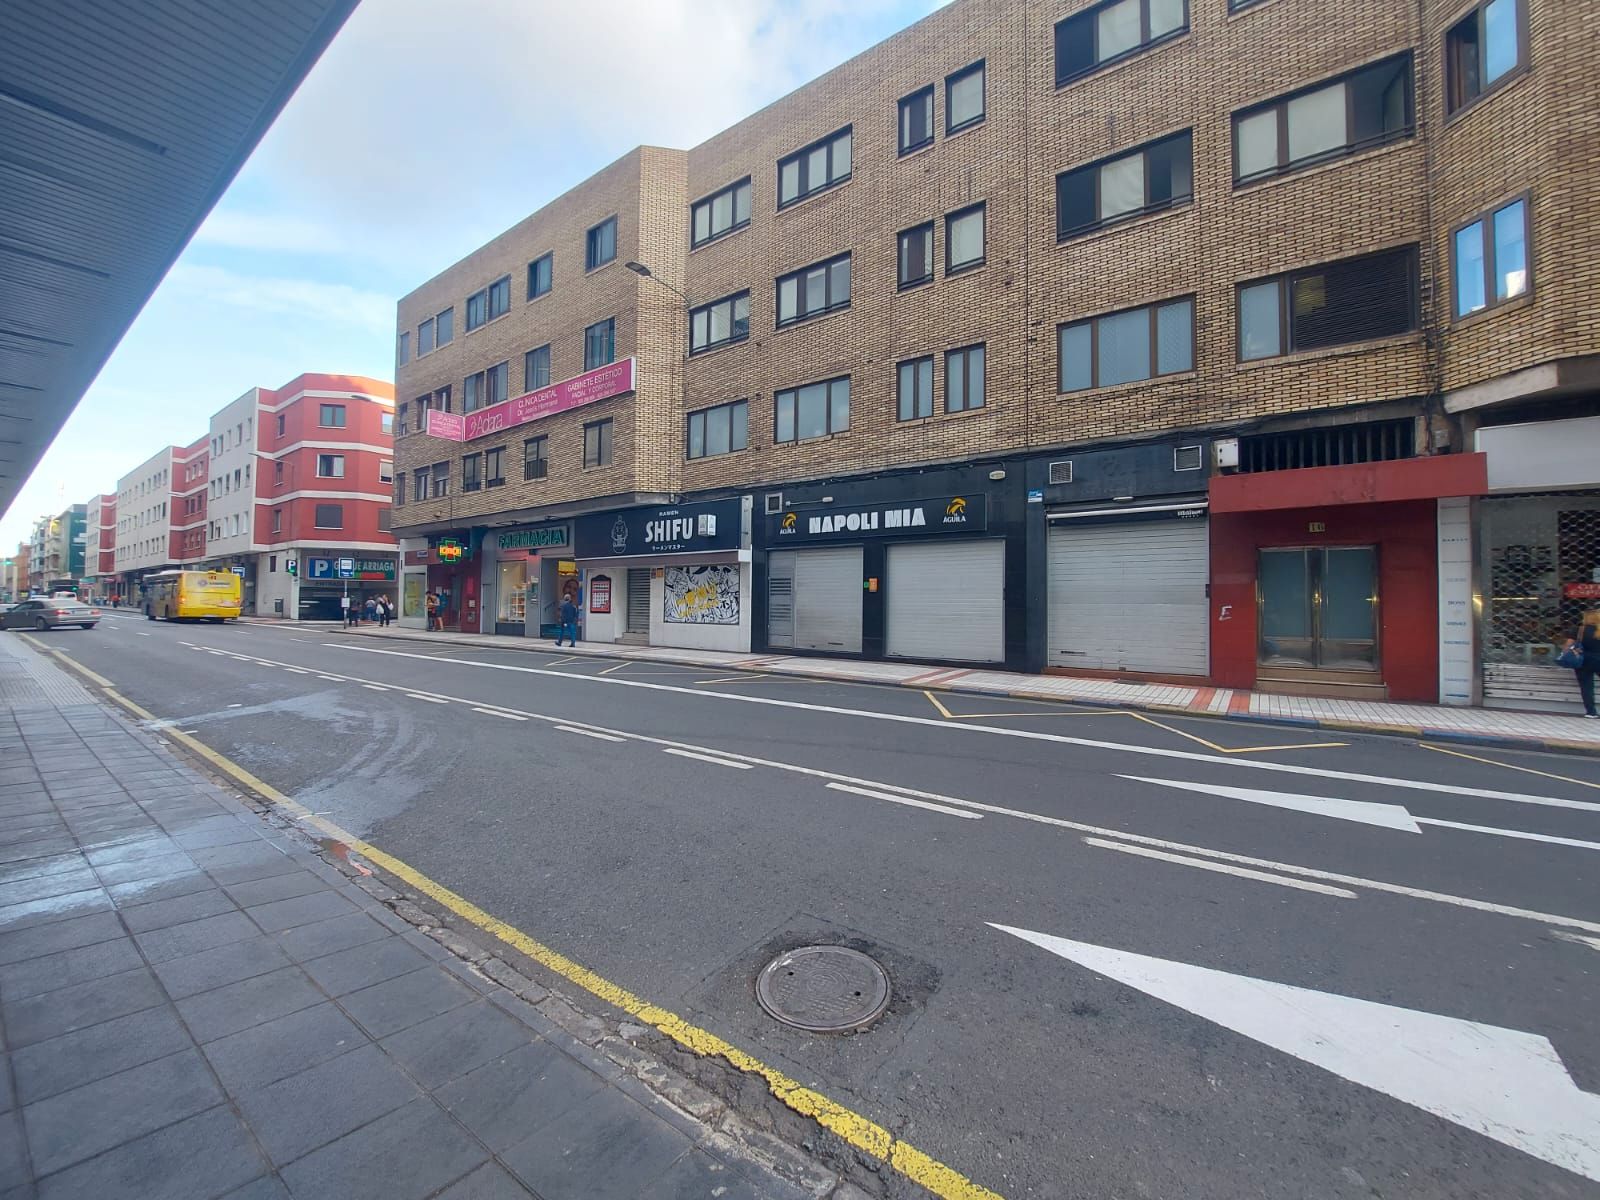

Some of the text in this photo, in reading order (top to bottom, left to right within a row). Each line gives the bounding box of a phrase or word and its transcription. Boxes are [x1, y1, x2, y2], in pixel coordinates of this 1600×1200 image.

[645, 517, 693, 543] SHIFU
[809, 507, 927, 534] NAPOLI MIA
[498, 529, 564, 550] FARMACIA
[314, 560, 329, 577] P
[362, 561, 395, 572] ARRIAGA
